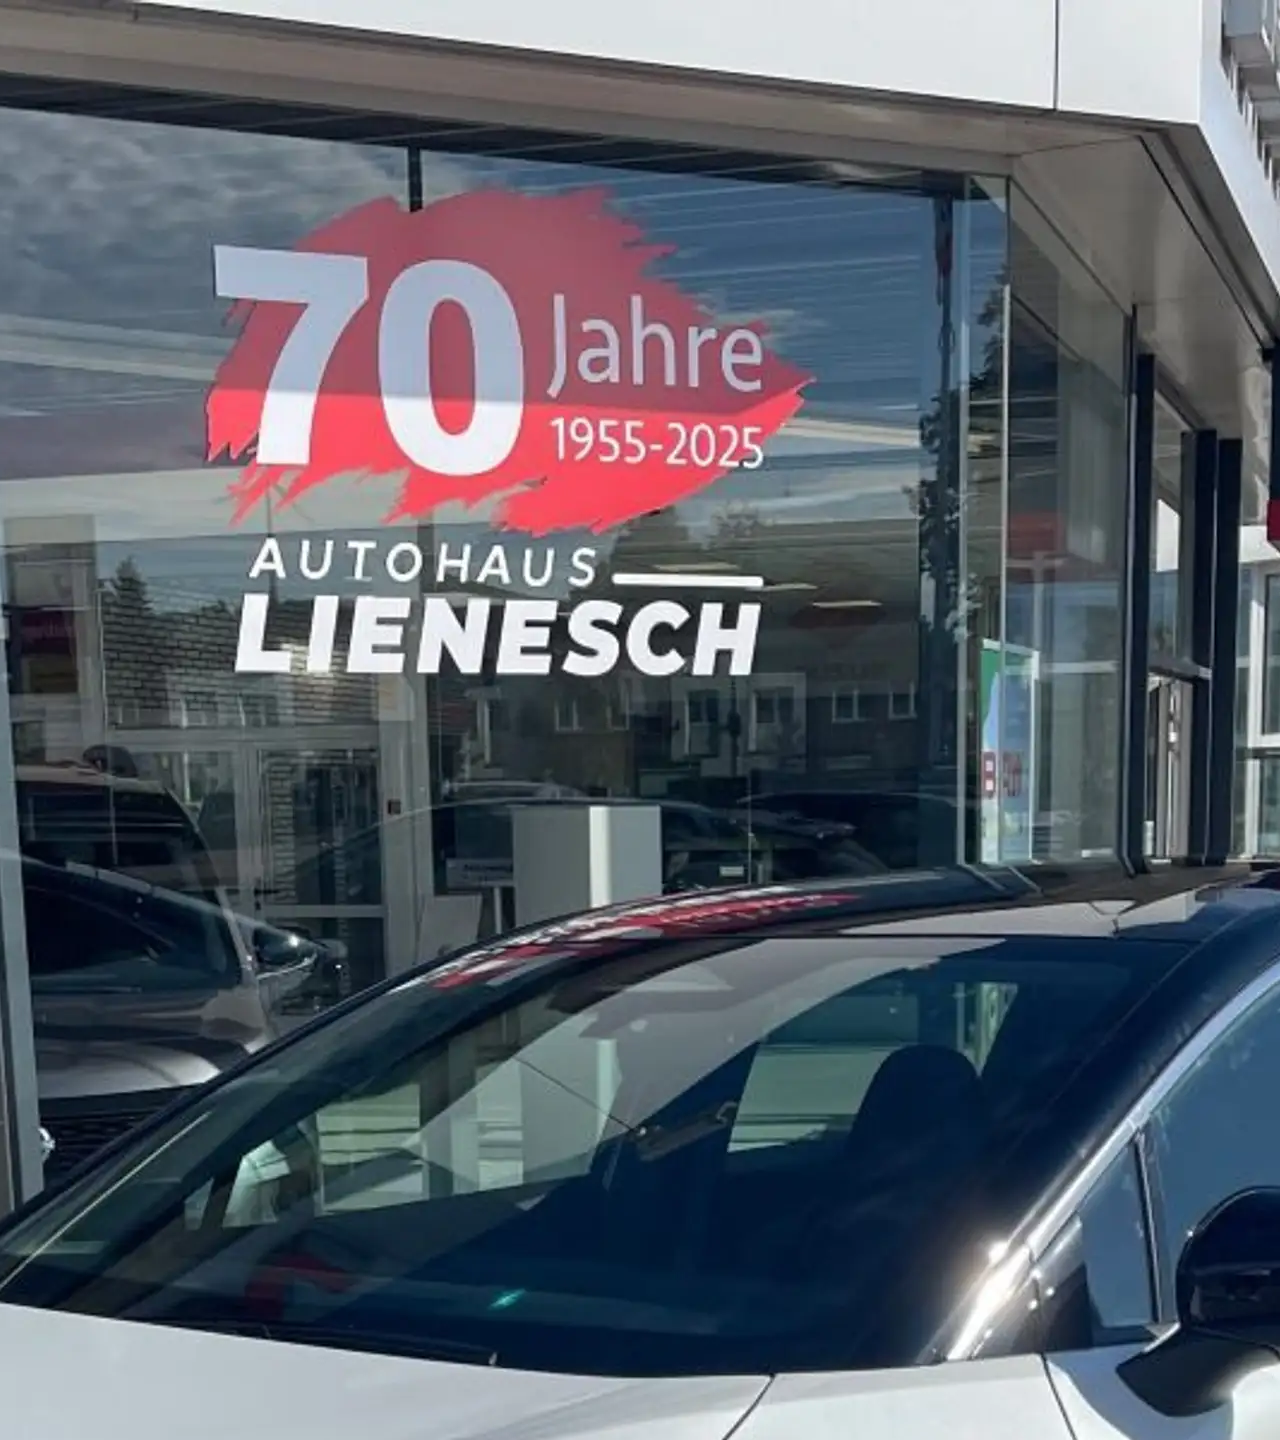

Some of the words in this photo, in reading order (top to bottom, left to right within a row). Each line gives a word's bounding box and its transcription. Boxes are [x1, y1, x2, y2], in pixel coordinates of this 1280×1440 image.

[214, 245, 524, 476] 70
[546, 293, 763, 398] Jahre
[549, 415, 764, 469] 1955-2025
[249, 537, 598, 588] AUTOHAUS
[235, 592, 761, 677] LIENESCH
